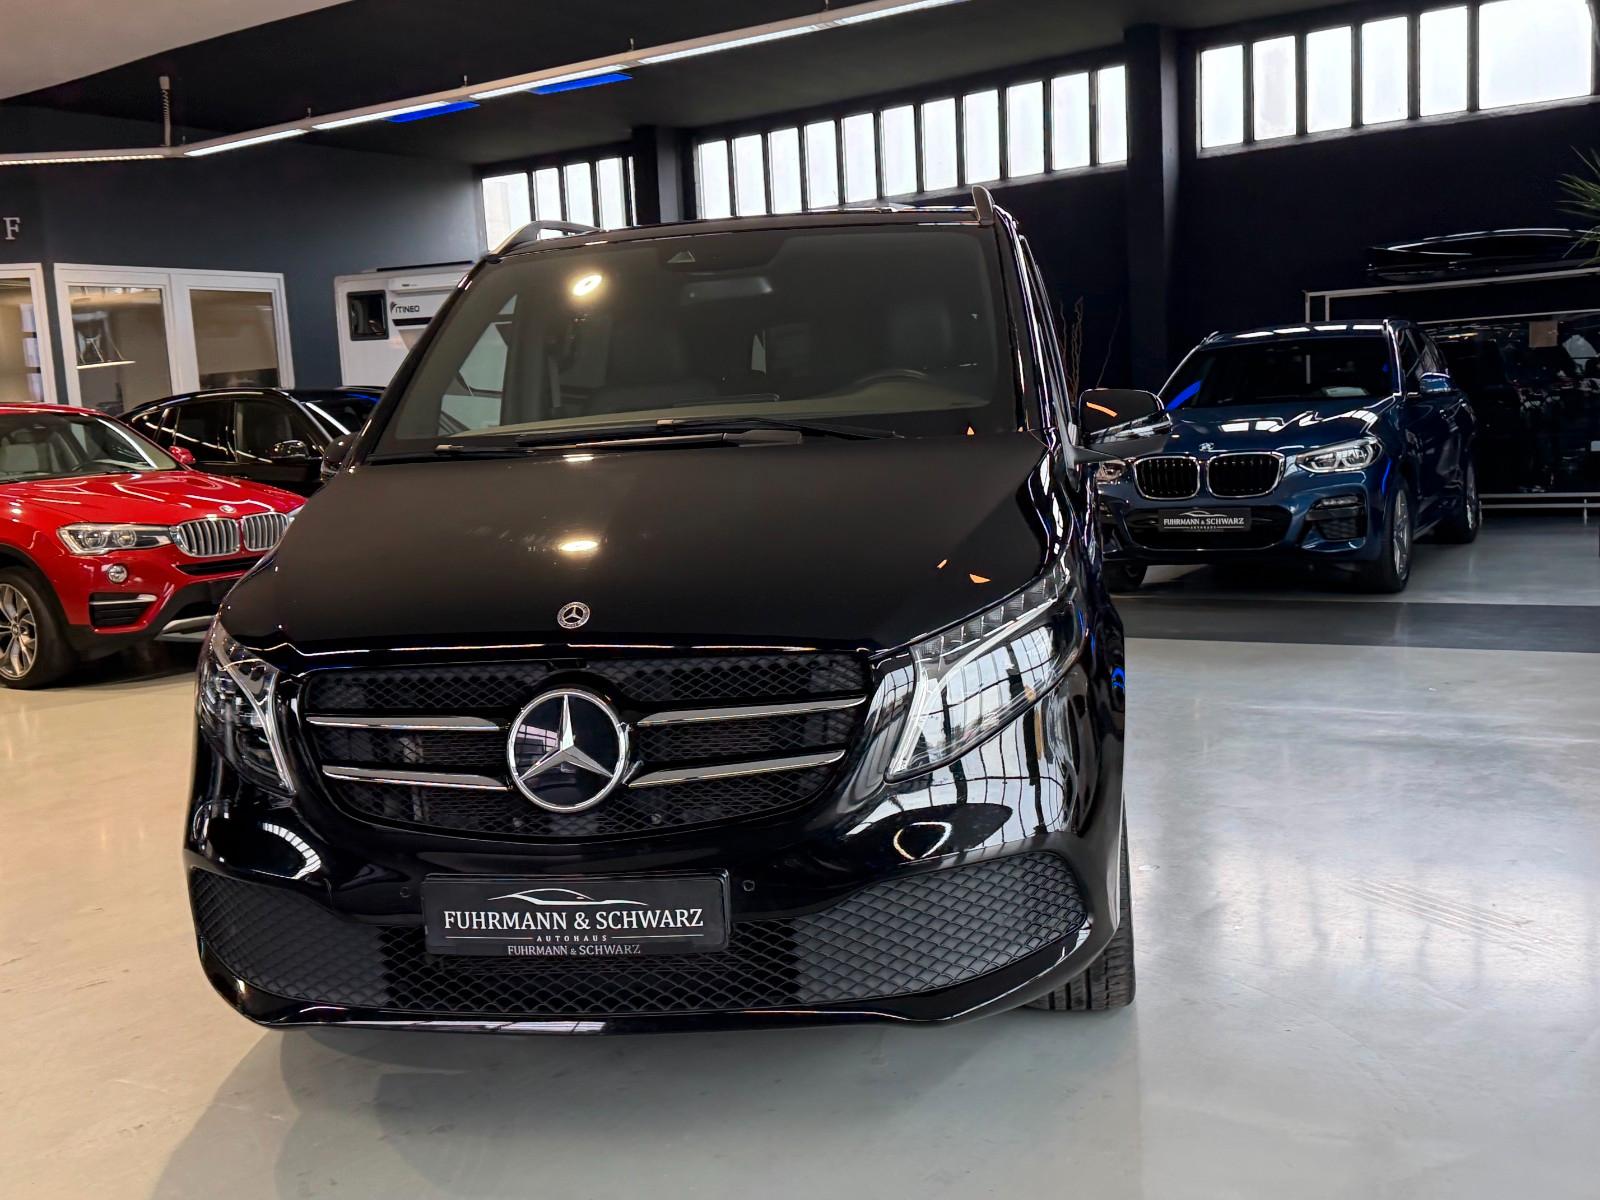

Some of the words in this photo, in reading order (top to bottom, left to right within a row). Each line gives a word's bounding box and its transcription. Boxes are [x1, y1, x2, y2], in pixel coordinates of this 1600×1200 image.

[3, 216, 21, 240] F
[1163, 518, 1200, 526] FUHRMANN
[1206, 517, 1244, 525] SCHWARZ
[444, 911, 567, 930] FUHRMANN
[573, 912, 591, 930] &
[596, 908, 704, 930] SCHWARZ
[536, 934, 608, 942] AUTOHAUS
[507, 945, 568, 956] FUHRMANN
[579, 944, 641, 955] SCHWARZ
